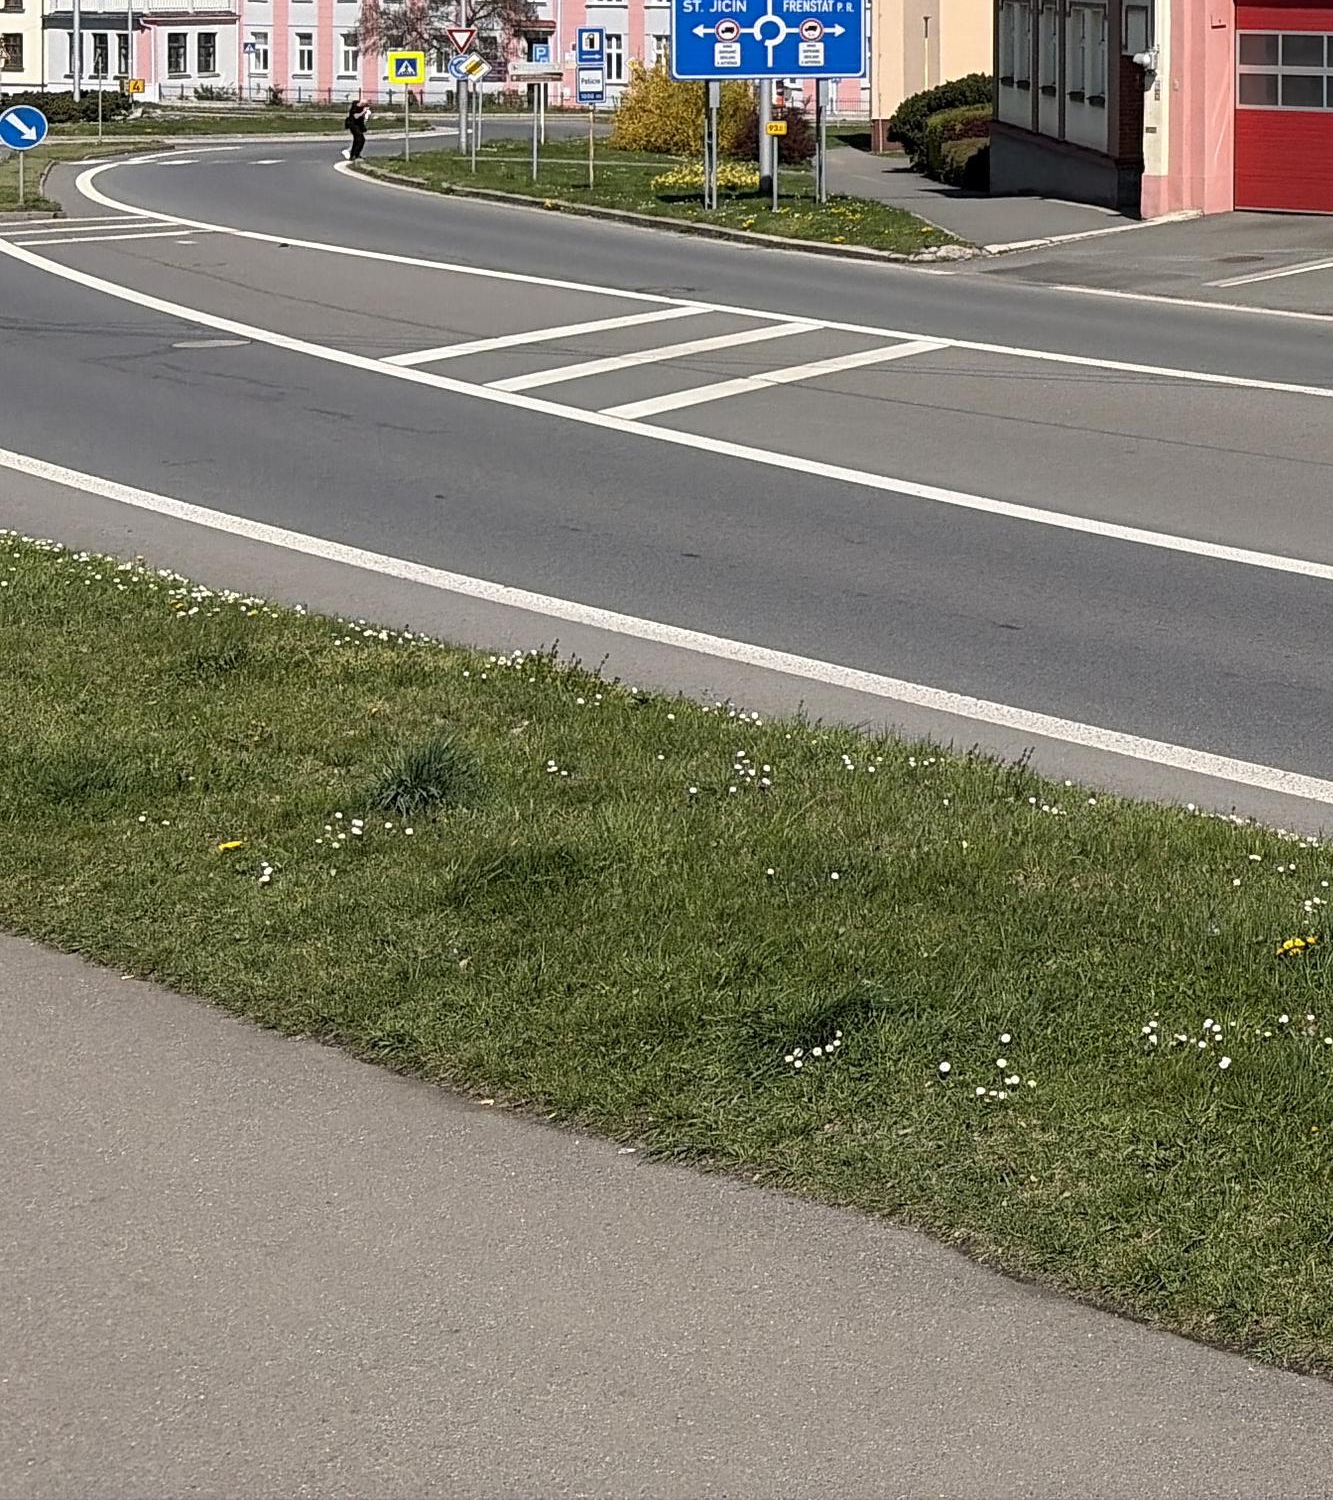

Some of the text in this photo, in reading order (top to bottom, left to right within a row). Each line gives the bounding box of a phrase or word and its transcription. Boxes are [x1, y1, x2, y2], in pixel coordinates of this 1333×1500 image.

[682, 0, 704, 13] ST.
[836, 2, 845, 13] P.
[846, 2, 854, 13] R.
[536, 47, 546, 60] P
[132, 81, 140, 92] 4
